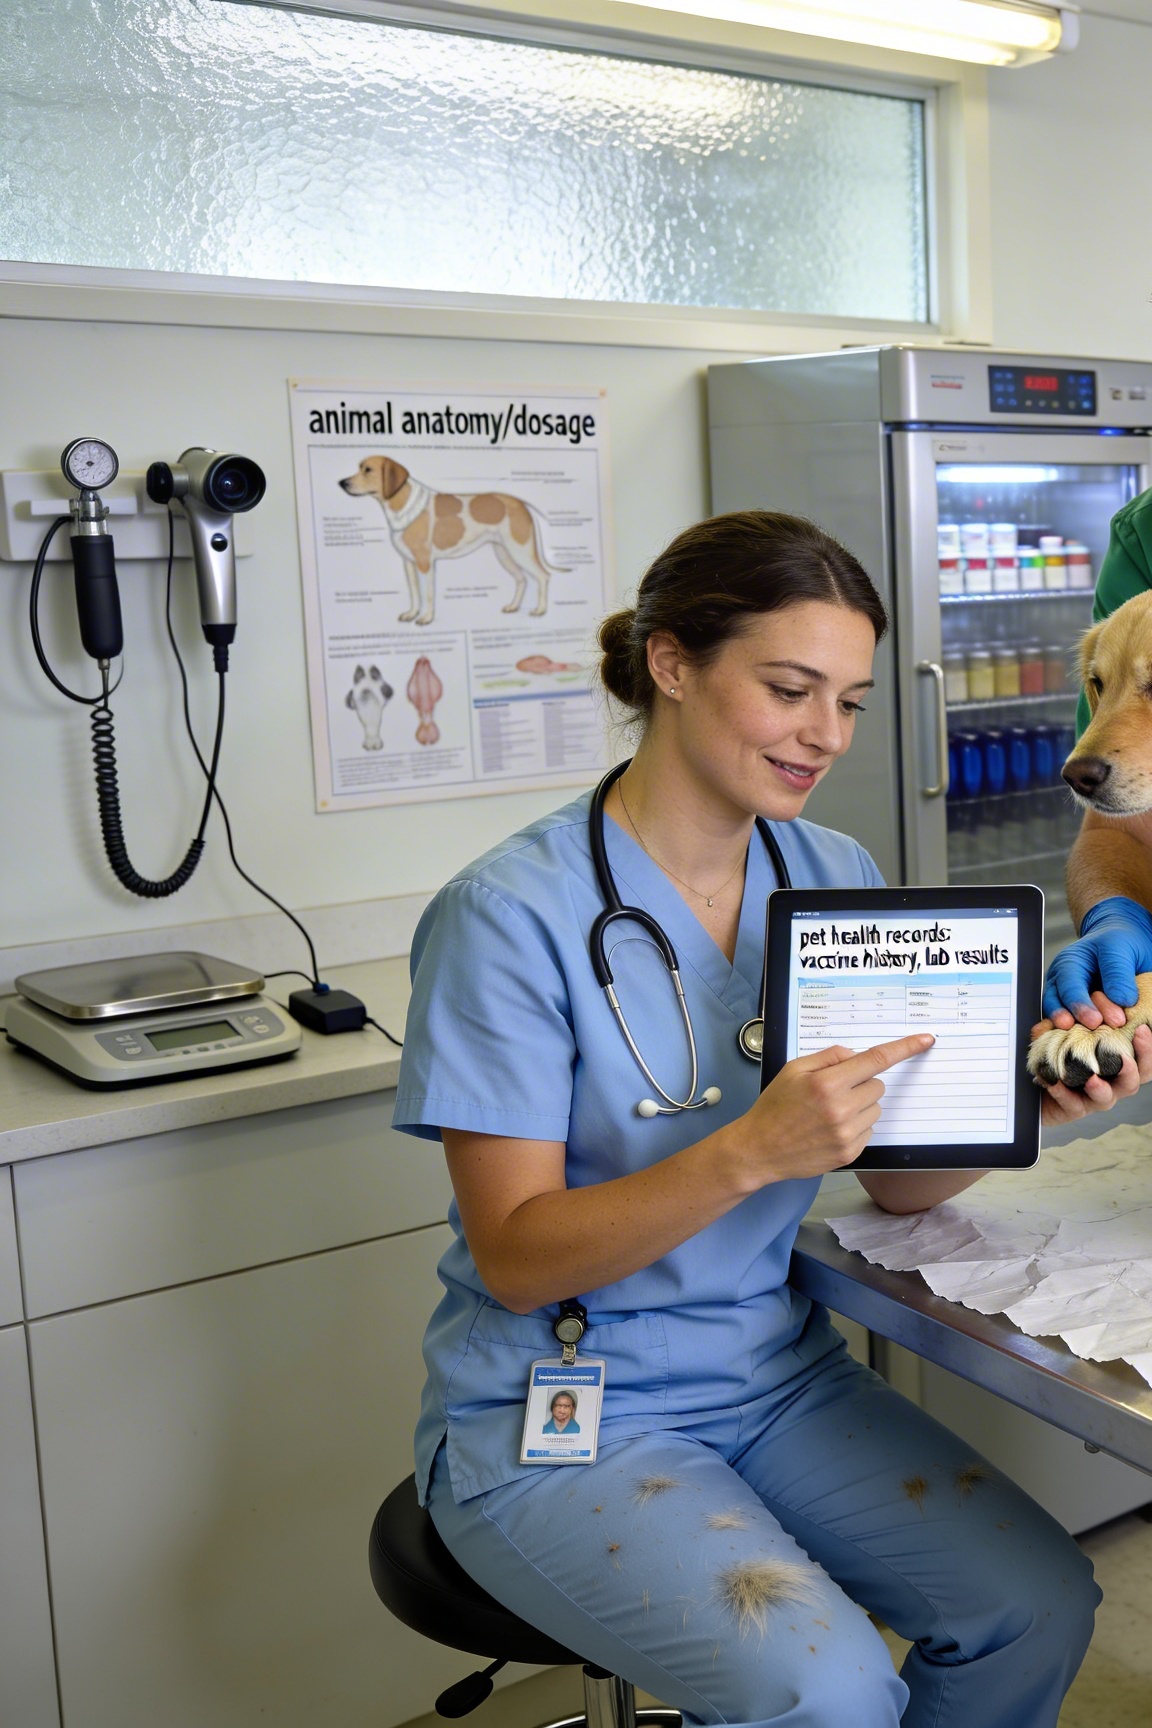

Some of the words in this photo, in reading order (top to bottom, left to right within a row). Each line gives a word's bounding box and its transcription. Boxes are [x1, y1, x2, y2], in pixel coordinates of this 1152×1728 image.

[309, 401, 393, 434] animal
[401, 404, 596, 444] anatomy/dosage
[800, 928, 826, 948] pet
[831, 924, 880, 945] health
